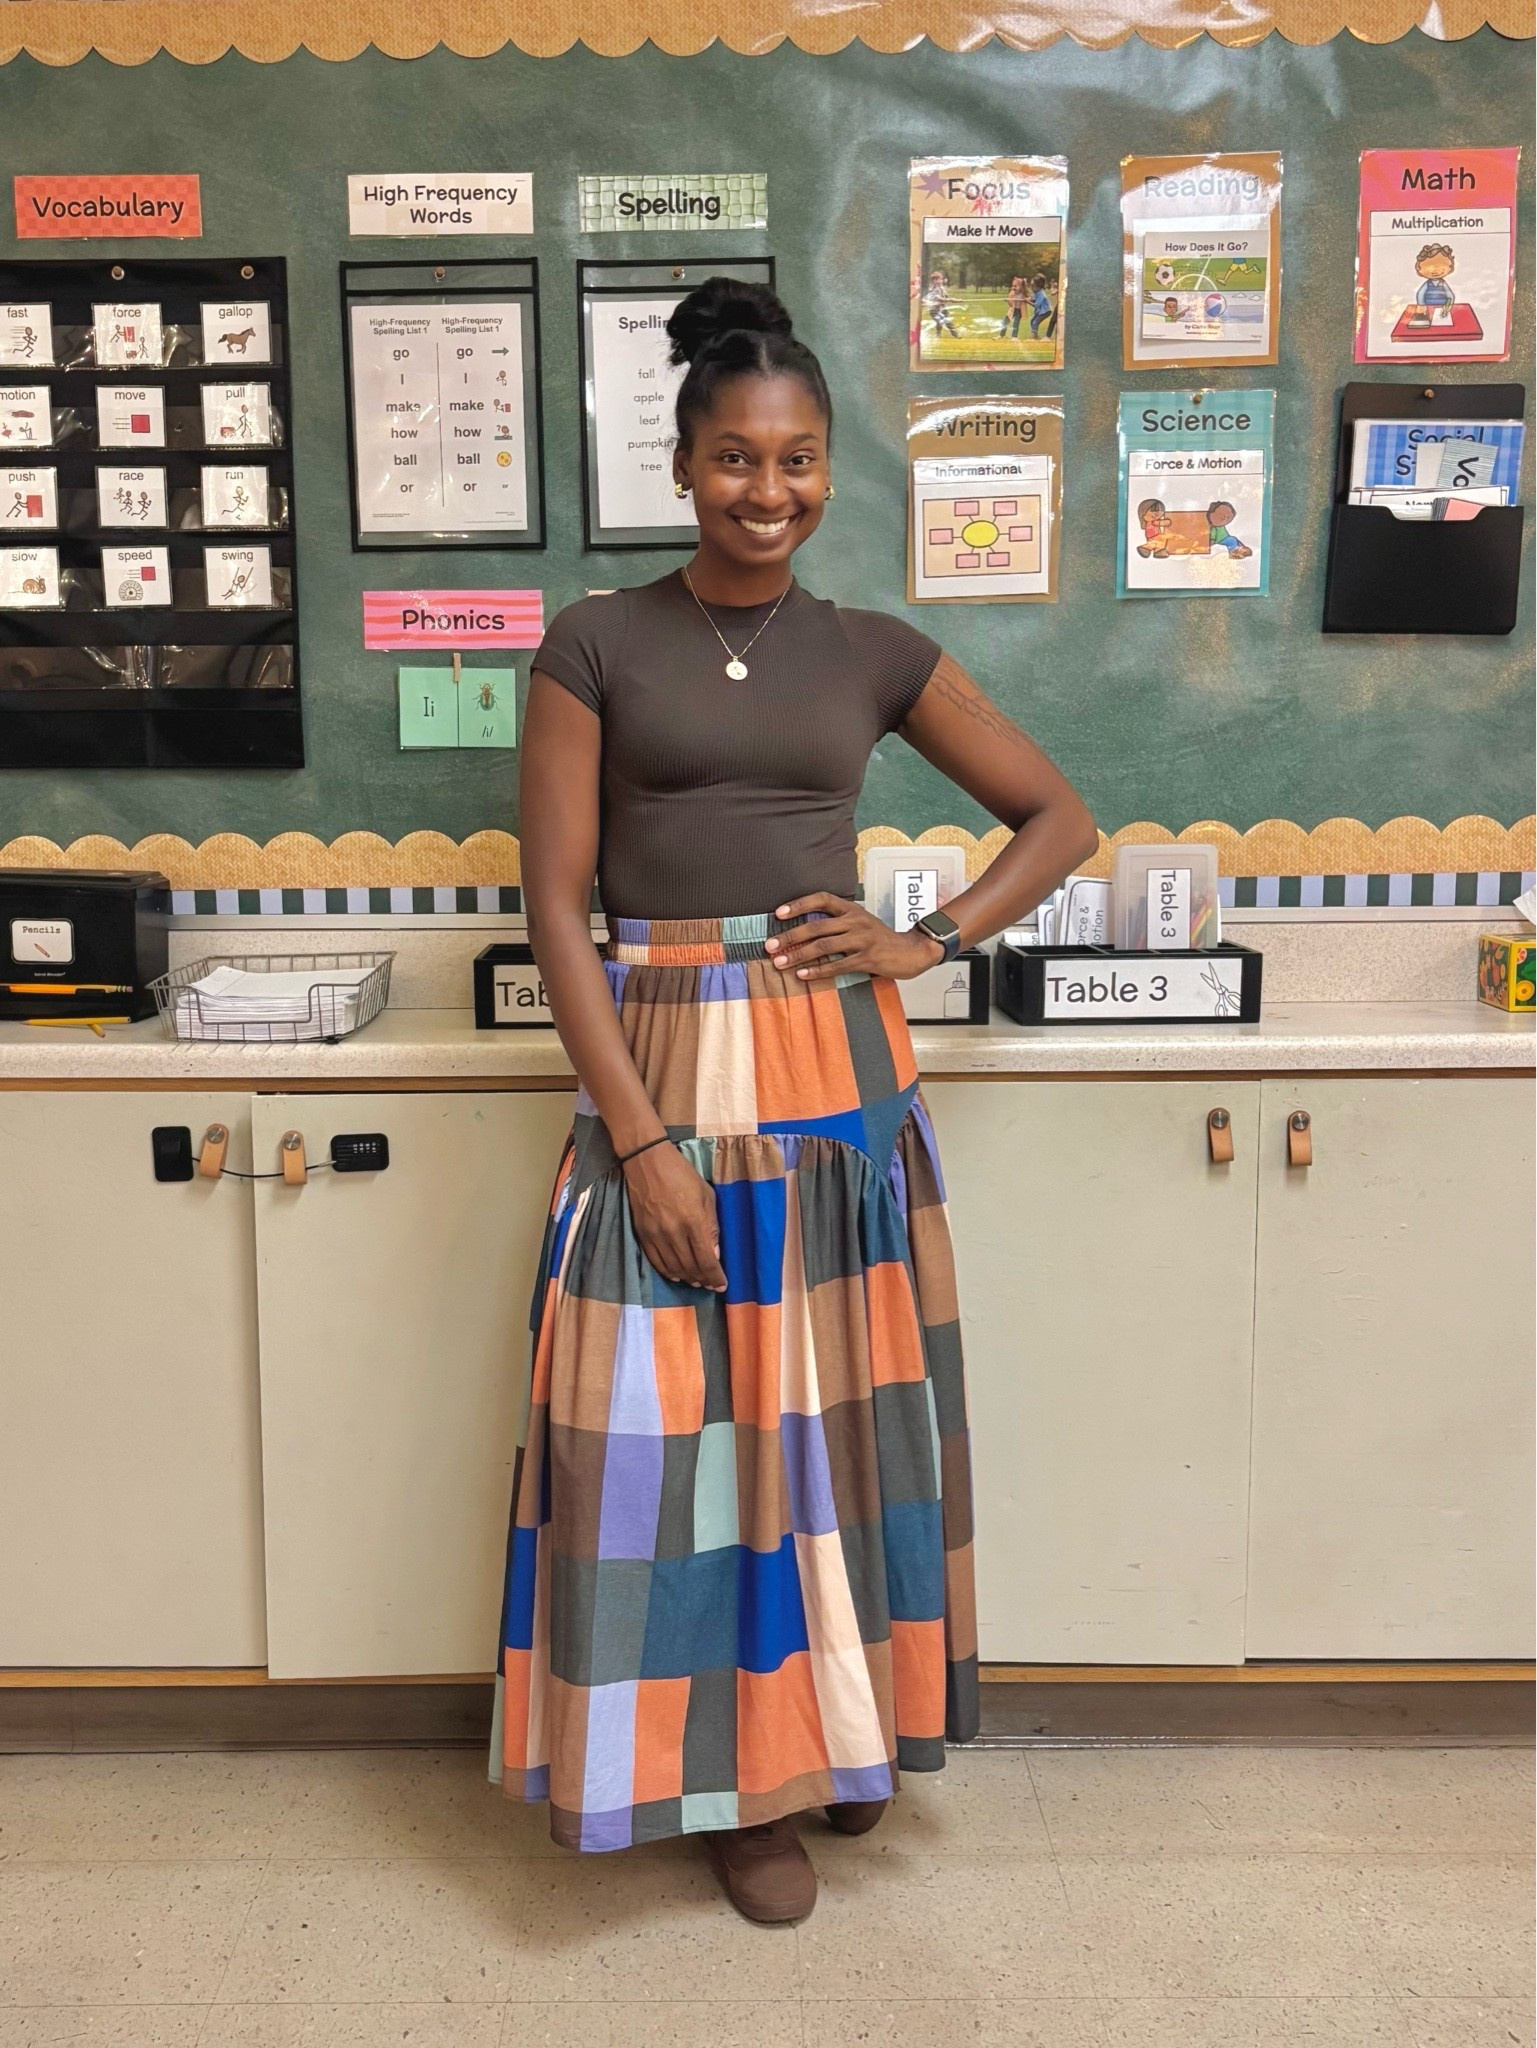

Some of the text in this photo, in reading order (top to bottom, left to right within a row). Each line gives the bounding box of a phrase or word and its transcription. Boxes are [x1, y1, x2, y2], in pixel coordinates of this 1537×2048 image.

[1401, 167, 1476, 191] Math
[948, 178, 1031, 200] Focus
[1144, 174, 1259, 201] Reading
[364, 185, 518, 206] High Frequency
[32, 192, 185, 224] Vocabulary
[618, 188, 721, 222] Spelling
[410, 208, 473, 224] Words
[1391, 215, 1484, 232] Multiplication
[947, 224, 1033, 237] Make It Move
[1165, 241, 1248, 252] How Does It Go?
[7, 306, 28, 318] fast
[113, 306, 142, 318] force
[218, 306, 253, 320] gallop
[369, 318, 431, 328] High-Frequency
[441, 317, 503, 326] High-Frequency
[373, 327, 405, 336] Spelling
[445, 326, 477, 334] Spelling
[479, 325, 493, 333] List
[393, 349, 410, 361] go
[456, 348, 473, 360] go
[638, 368, 655, 379] fall
[114, 391, 146, 400] move
[225, 387, 246, 401] pull
[633, 392, 664, 405] apple
[386, 401, 421, 412] make
[449, 400, 484, 411] make
[639, 415, 660, 426] leaf
[1142, 409, 1251, 433] Science
[391, 427, 418, 438] how
[454, 426, 481, 437] how
[628, 438, 674, 451] pumpkin
[394, 454, 417, 466] ball
[457, 453, 481, 465] ball
[1145, 457, 1242, 470] Force & Motion
[640, 462, 663, 471] tree
[935, 464, 1022, 478] Informational
[8, 471, 36, 484] push
[118, 472, 145, 481] race
[225, 471, 244, 480] run
[400, 483, 414, 492] or
[463, 482, 477, 491] or
[11, 552, 38, 562] slow
[118, 549, 153, 563] speed
[221, 551, 254, 563] swing
[402, 609, 505, 631] Phonics
[423, 696, 434, 717] Ii
[907, 872, 926, 922] Table
[1080, 905, 1089, 914] &
[1160, 870, 1179, 938] Table 3
[22, 926, 61, 934] Pencils
[1091, 909, 1104, 945] otion
[1047, 971, 1168, 1003] Table 3
